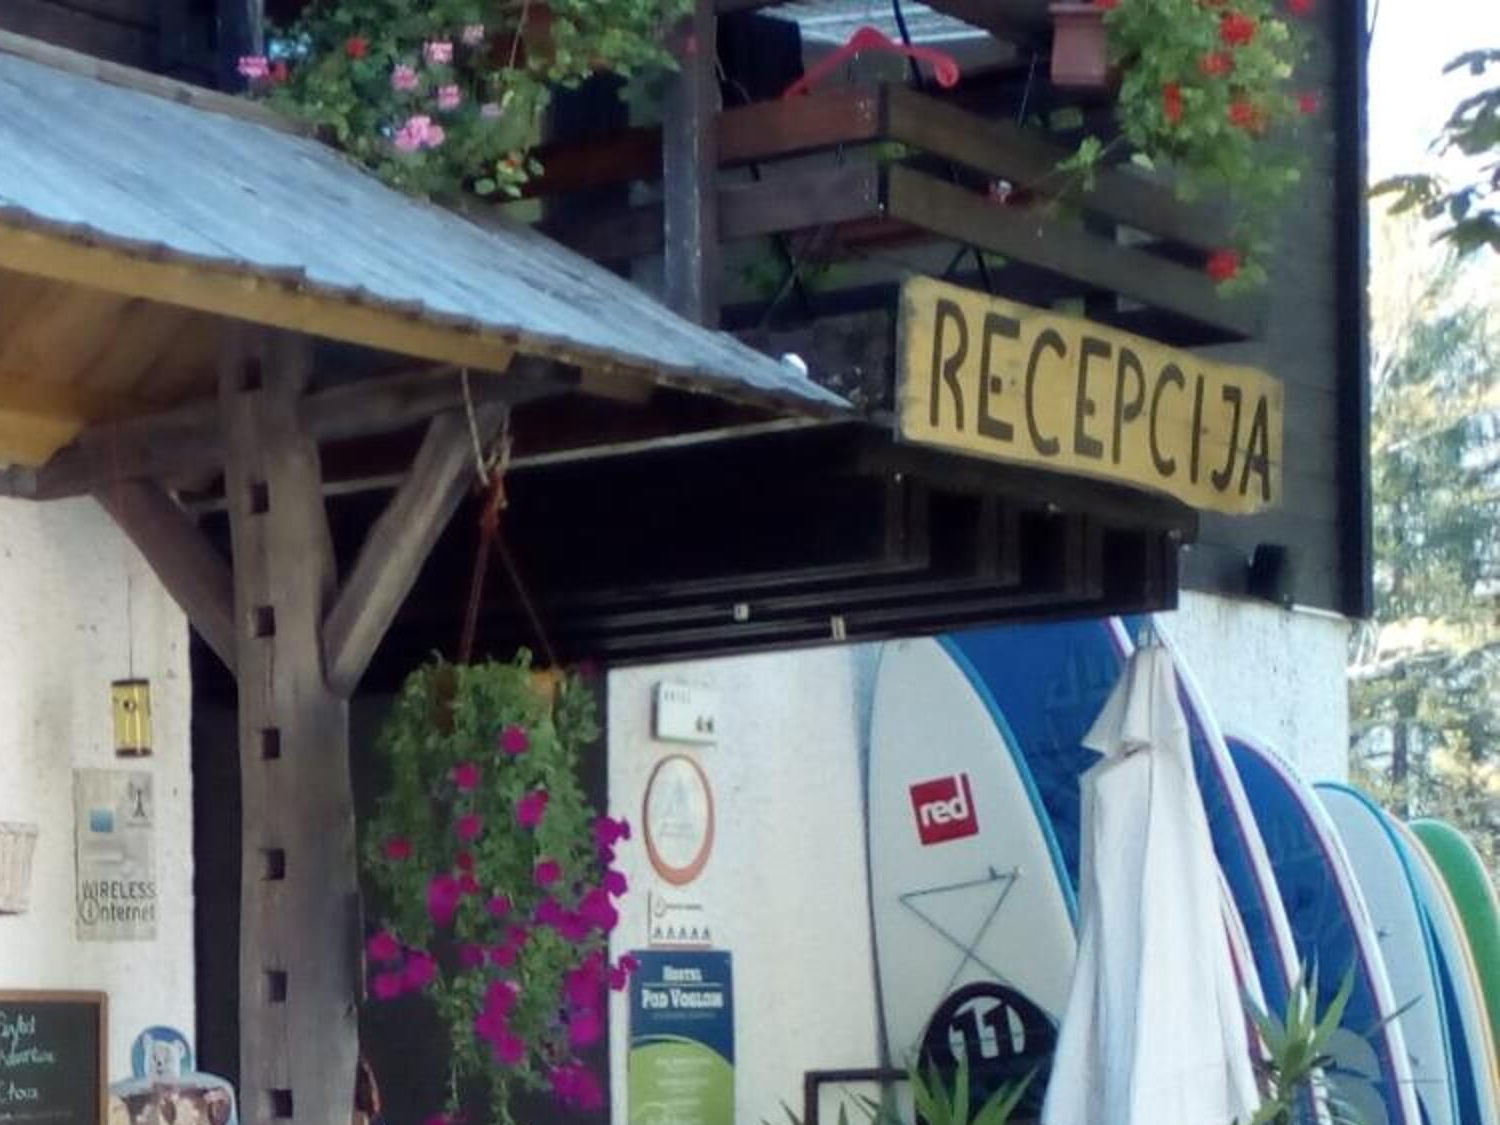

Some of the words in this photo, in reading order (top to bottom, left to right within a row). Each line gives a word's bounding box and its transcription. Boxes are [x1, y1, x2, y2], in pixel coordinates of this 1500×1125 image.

[929, 298, 1271, 501] RECEPCIJA
[918, 771, 970, 826] red
[81, 879, 158, 899] WIRELESS
